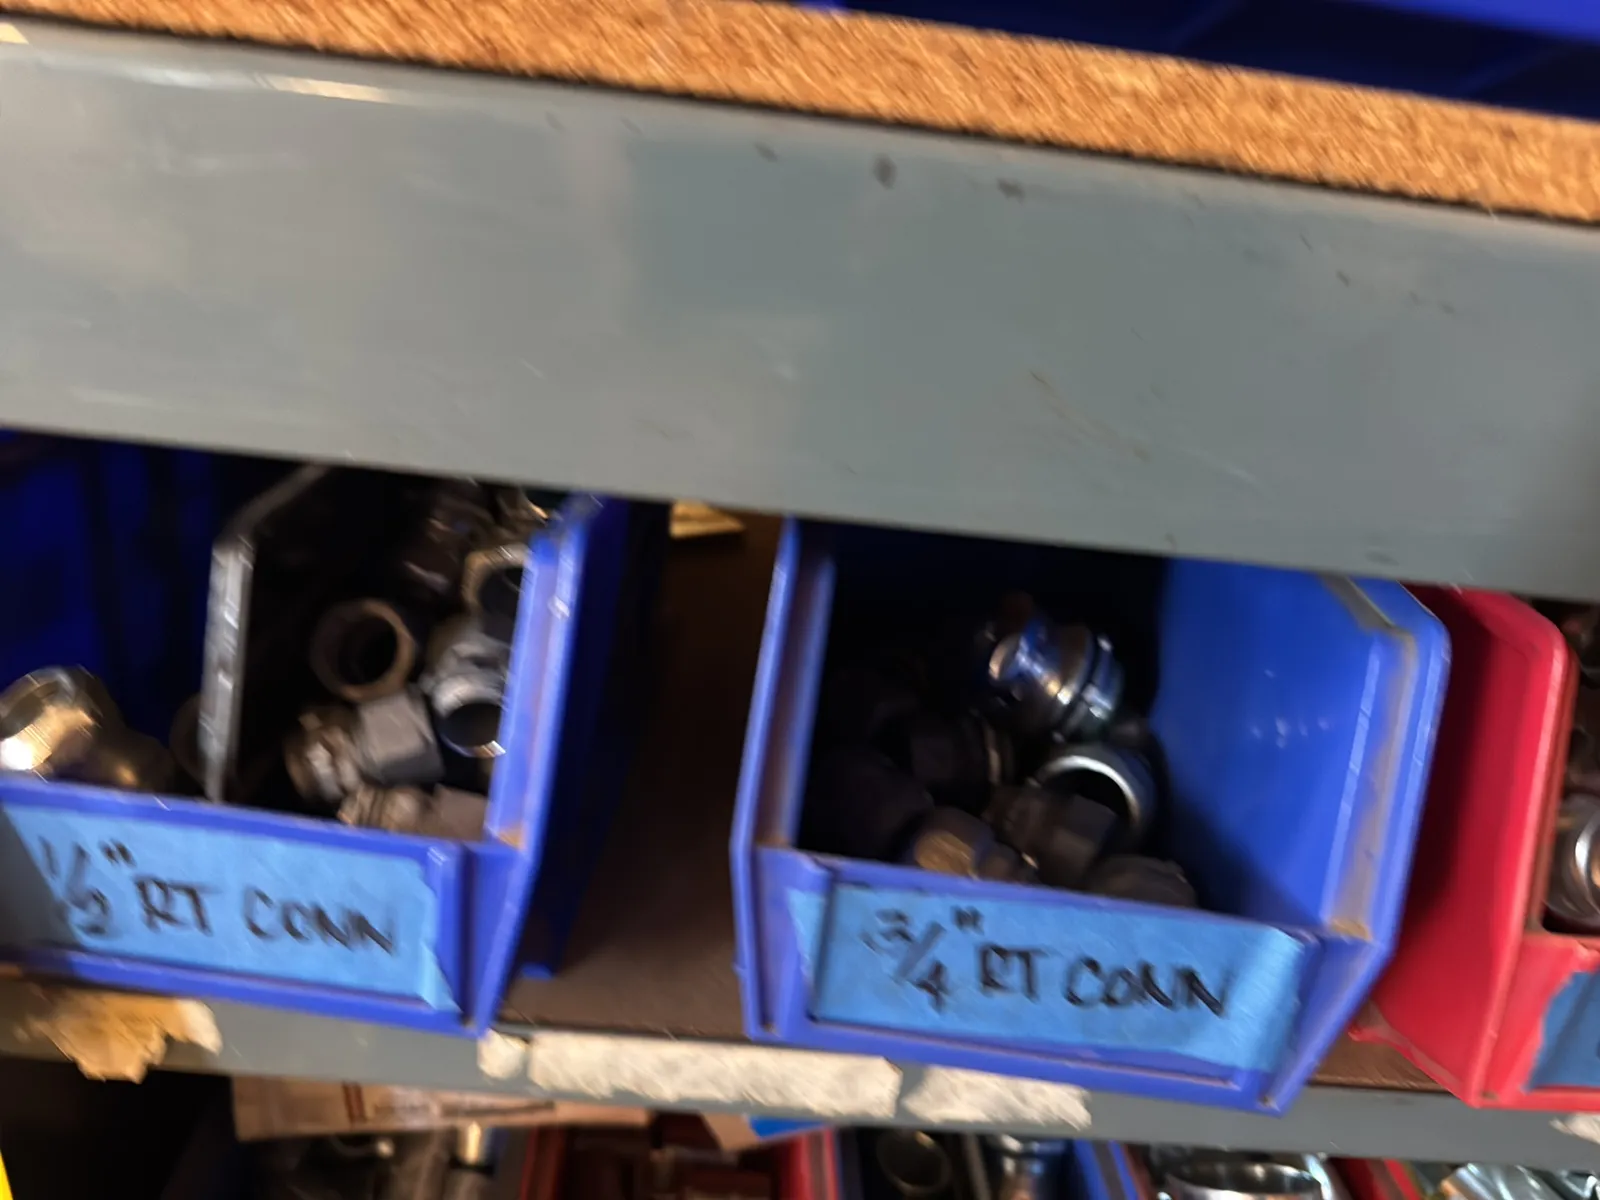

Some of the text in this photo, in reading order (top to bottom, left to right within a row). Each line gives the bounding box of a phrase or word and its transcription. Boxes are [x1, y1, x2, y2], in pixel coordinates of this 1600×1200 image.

[134, 875, 220, 936] RT
[241, 886, 396, 956] CONN
[977, 943, 1058, 1001] RT
[1064, 956, 1230, 1018] CONN
